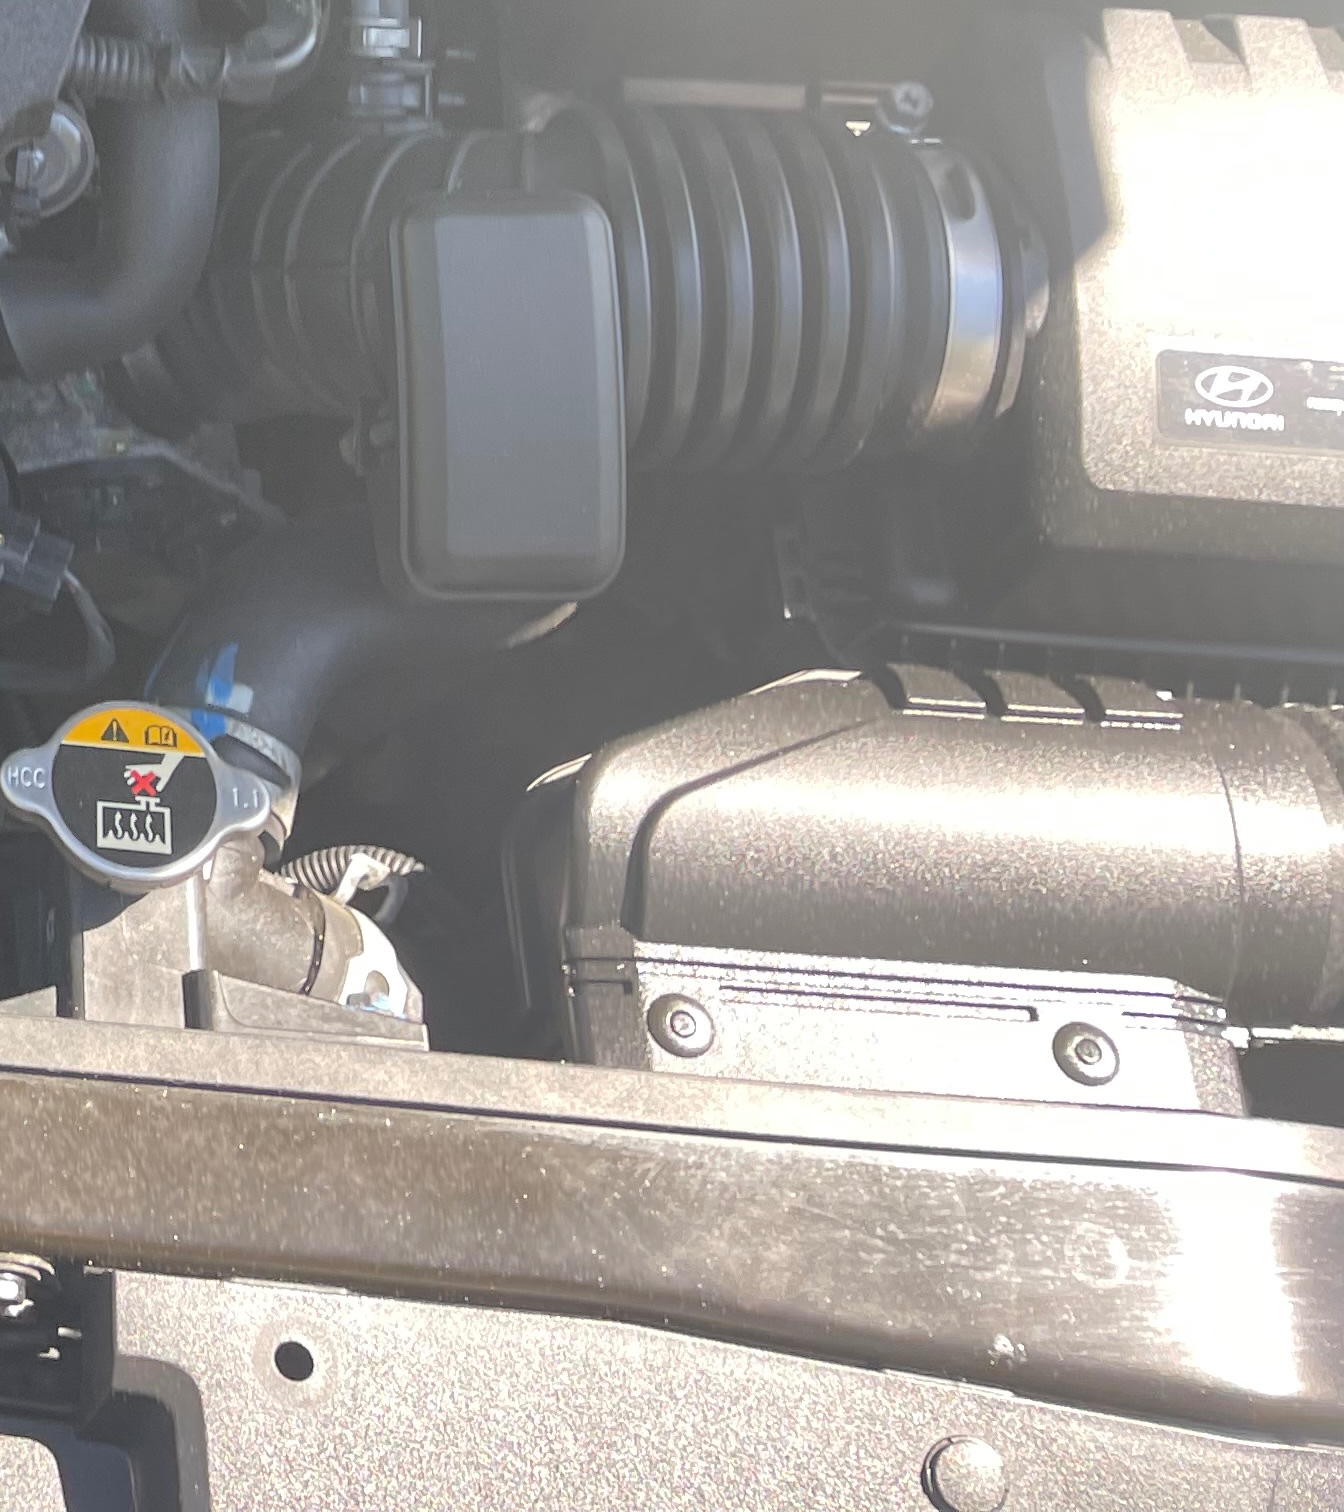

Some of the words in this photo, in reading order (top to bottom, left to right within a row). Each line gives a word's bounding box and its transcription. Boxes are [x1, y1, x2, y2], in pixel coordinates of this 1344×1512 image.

[1184, 407, 1286, 432] HYUNDAI
[6, 765, 47, 789] HCC
[231, 786, 260, 810] 1.1
